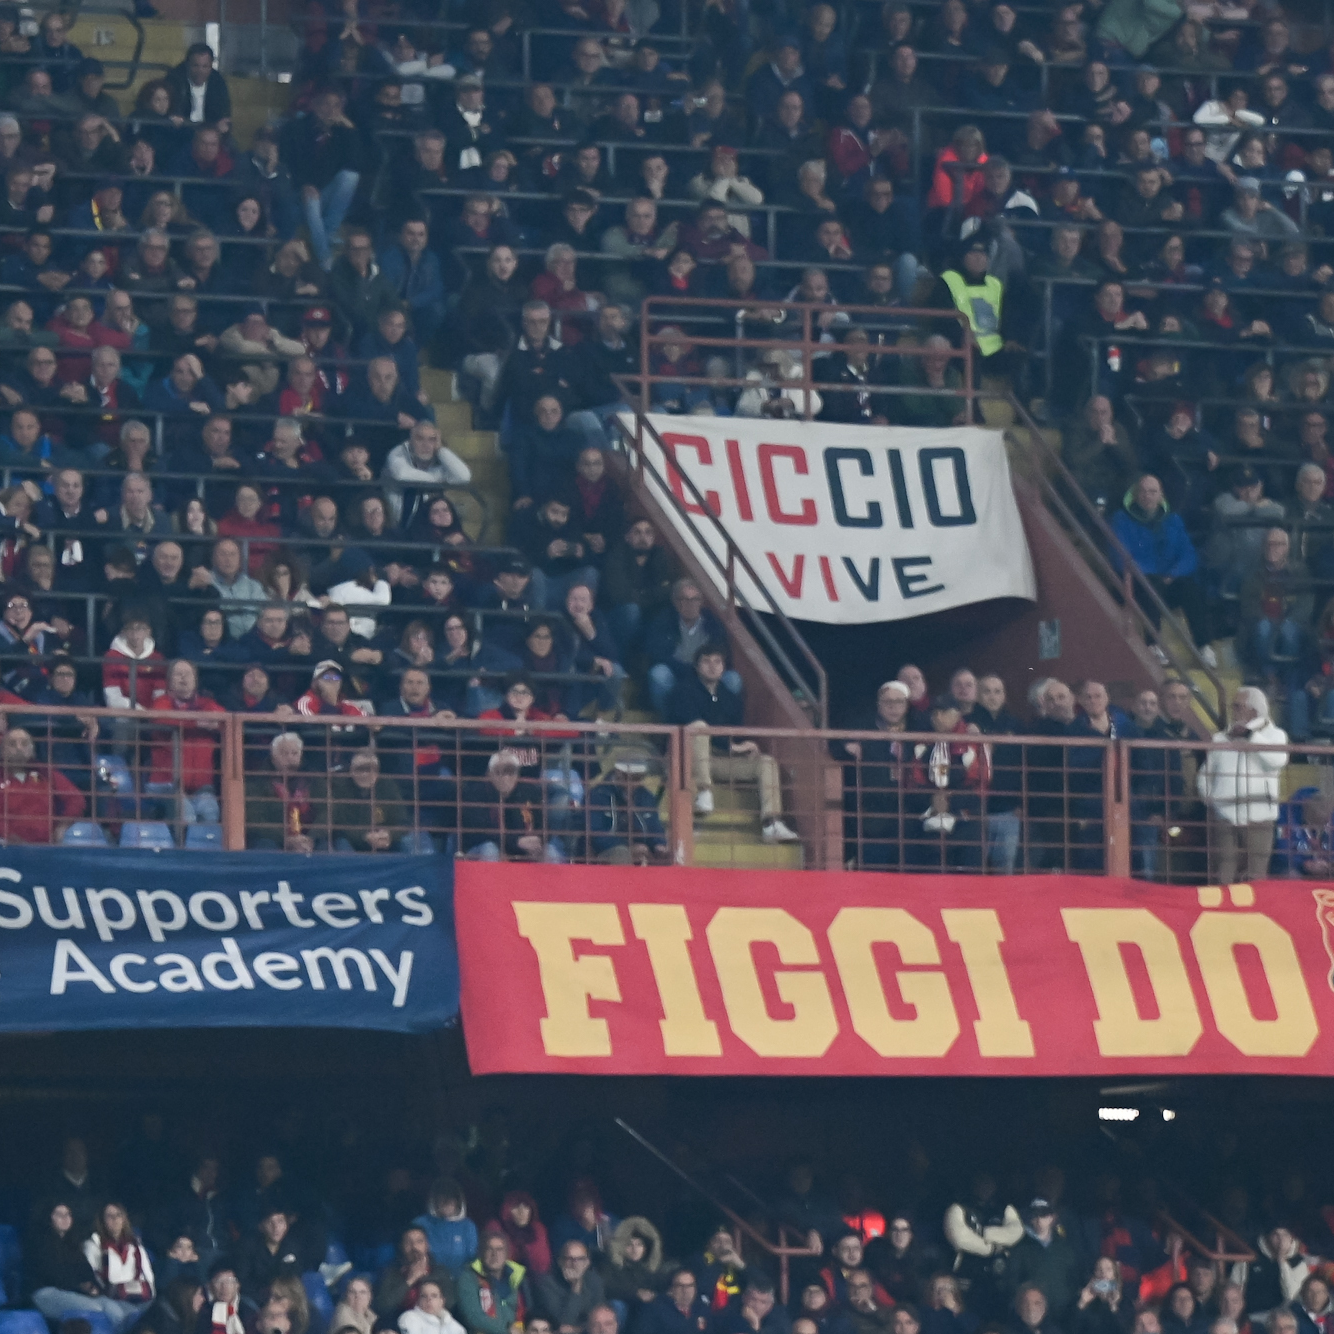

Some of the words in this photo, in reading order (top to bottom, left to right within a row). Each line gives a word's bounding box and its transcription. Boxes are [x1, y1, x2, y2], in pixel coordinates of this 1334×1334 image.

[660, 431, 977, 529] CICCIO
[764, 551, 945, 602] VIVE
[49, 937, 414, 1007] Academy
[510, 900, 1036, 1058] FIGGI
[1060, 884, 1321, 1058] DÖ
